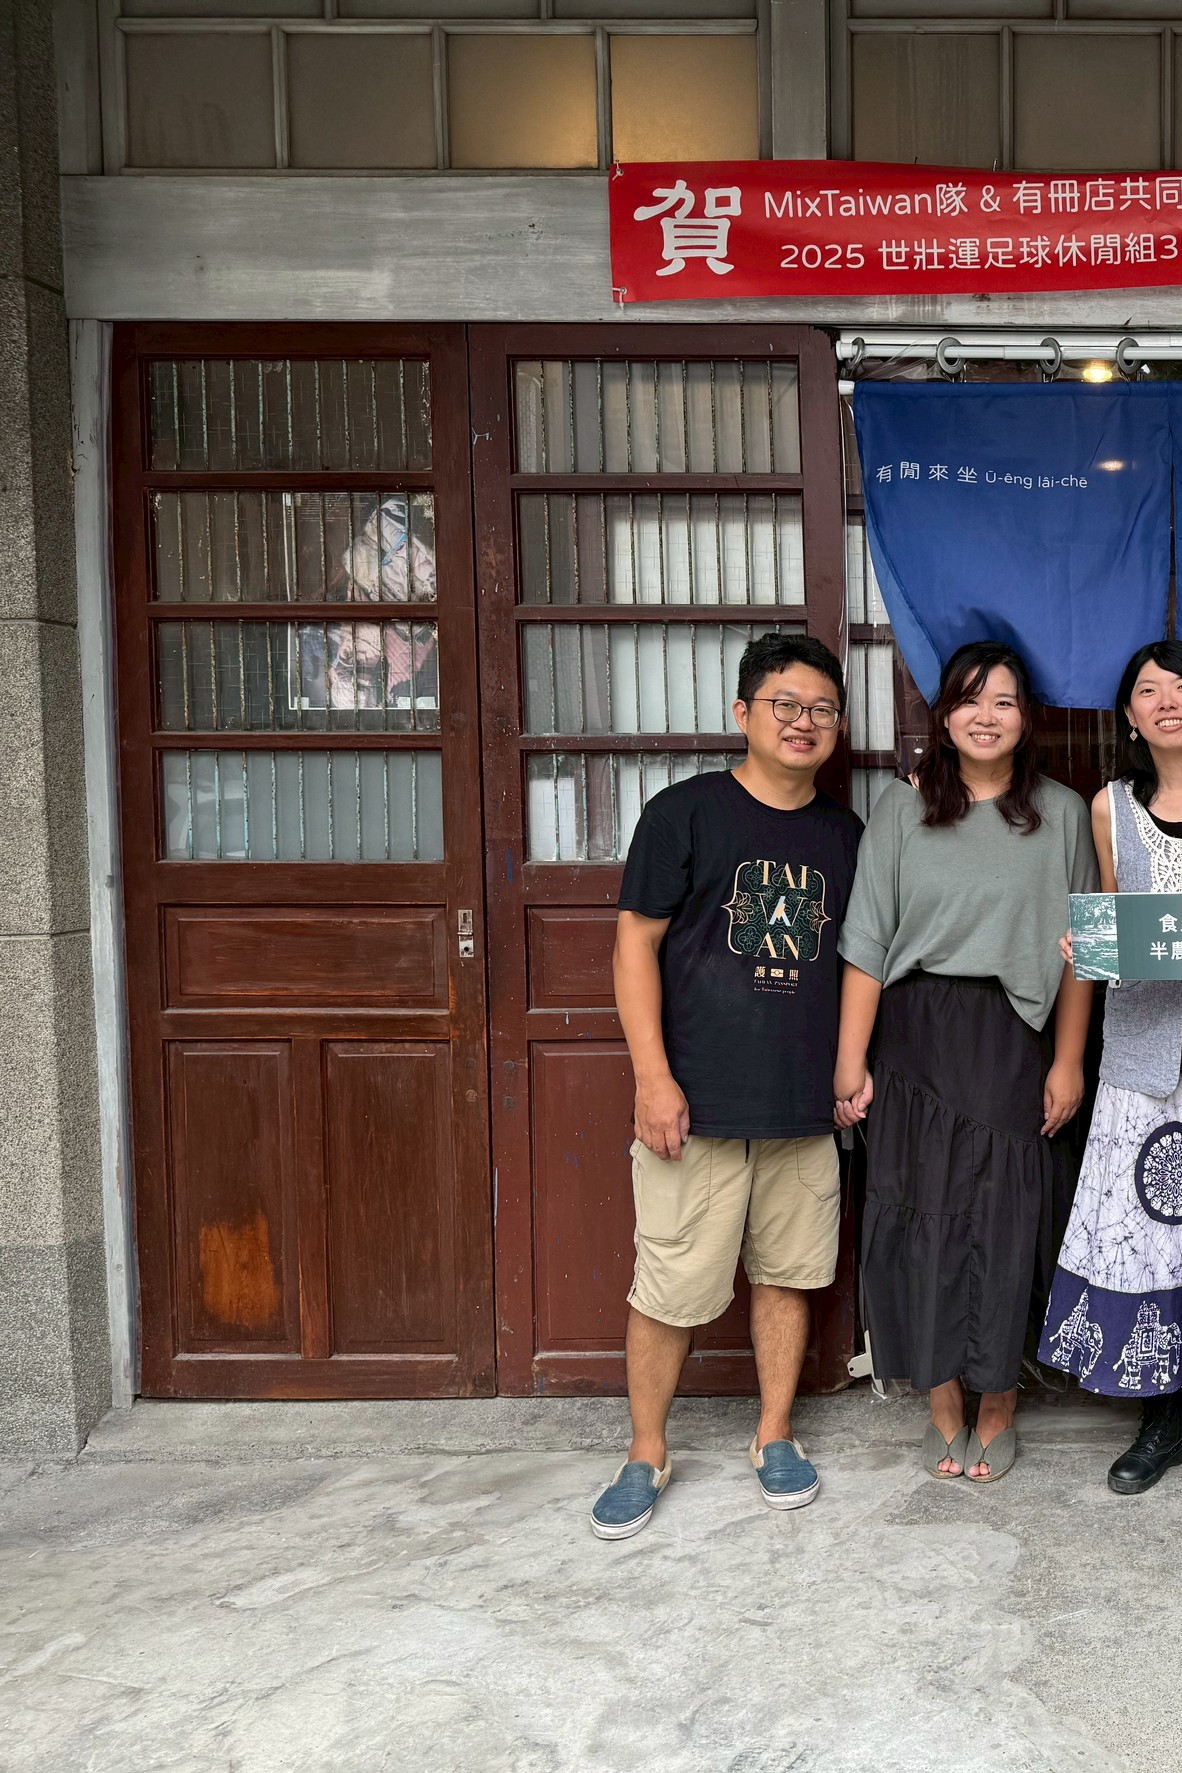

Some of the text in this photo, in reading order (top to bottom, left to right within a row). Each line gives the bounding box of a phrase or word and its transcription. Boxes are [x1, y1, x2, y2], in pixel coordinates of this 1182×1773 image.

[764, 182, 968, 218] MixTaiwan隊
[980, 187, 1002, 213] &
[633, 179, 742, 277] 賀
[780, 244, 865, 269] 2025
[876, 461, 978, 484] 有閒來坐
[757, 859, 809, 890] TAI
